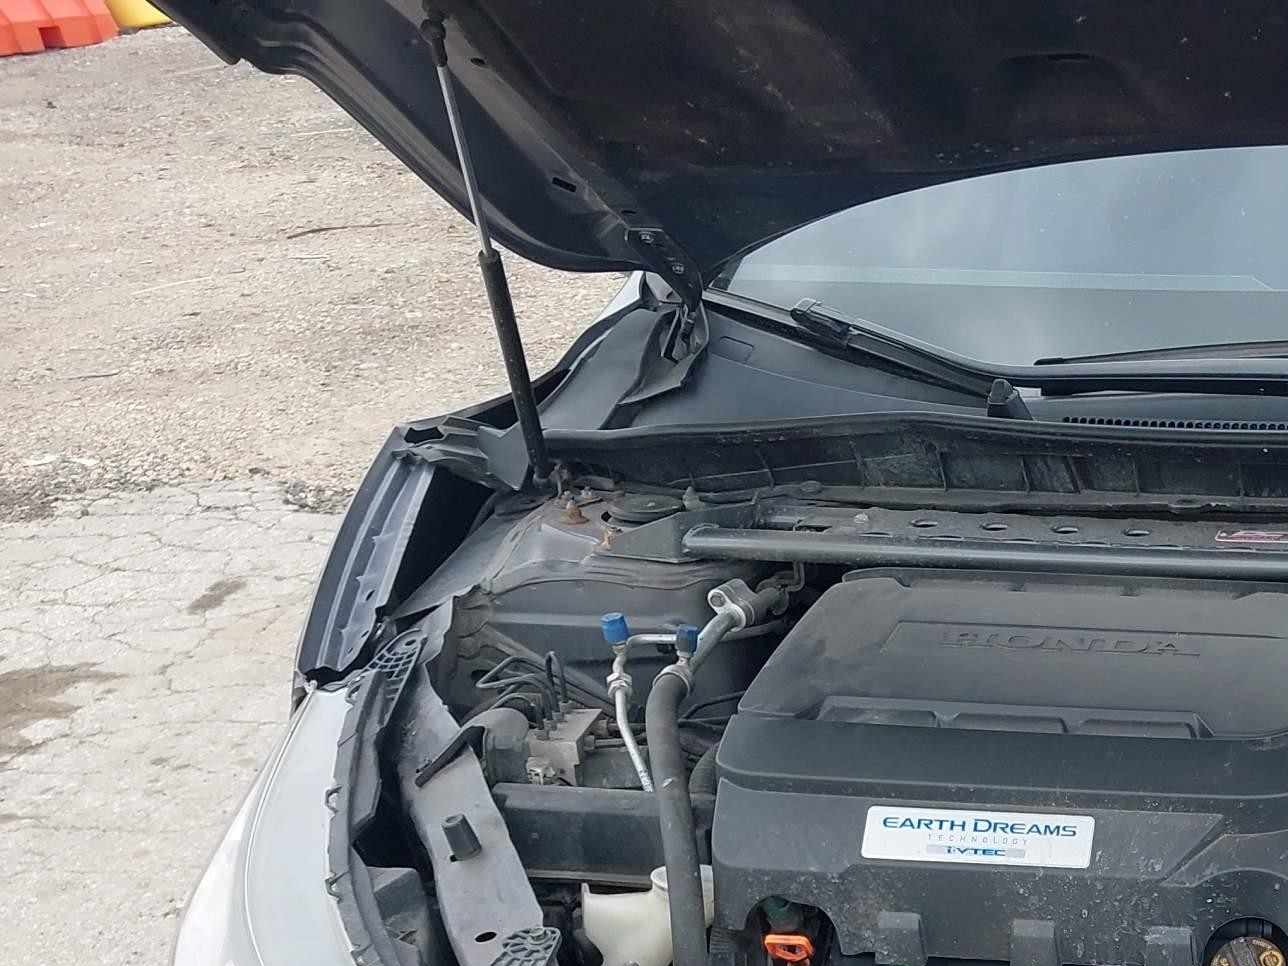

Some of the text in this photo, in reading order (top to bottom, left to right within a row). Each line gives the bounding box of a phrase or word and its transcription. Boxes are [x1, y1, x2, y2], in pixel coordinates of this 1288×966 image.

[936, 632, 1201, 657] HONDA
[882, 816, 1077, 837] EARTH DREAMS
[927, 834, 1029, 845] TECHNOLOGY
